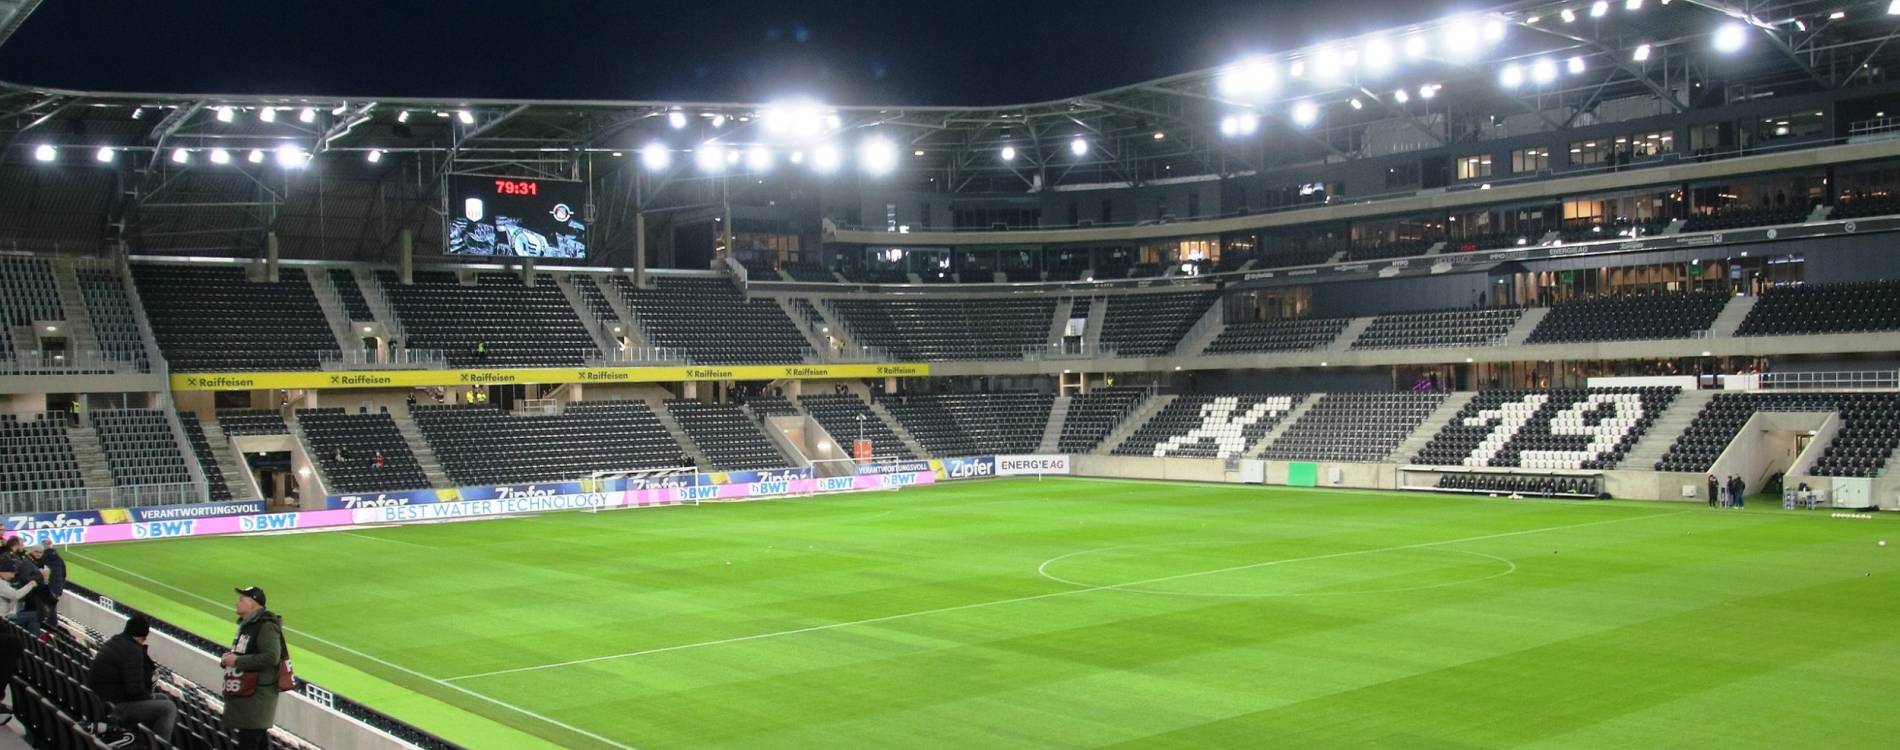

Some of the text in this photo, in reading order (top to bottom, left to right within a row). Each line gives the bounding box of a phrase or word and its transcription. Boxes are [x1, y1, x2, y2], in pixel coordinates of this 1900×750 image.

[495, 181, 537, 195] 79:31
[587, 371, 628, 380] Raiffeisen
[694, 369, 732, 379] Raiffeisen
[793, 367, 828, 377] Raiffeisen
[883, 366, 916, 375] Raiffeisen
[199, 377, 254, 387] Raiffeisen
[341, 375, 391, 385] Raiffeisen
[470, 373, 515, 382] Raiffeisen
[951, 459, 993, 477] Zipfer
[1049, 460, 1064, 469] AG
[828, 477, 854, 490] BWT
[891, 474, 916, 486] BWT
[688, 486, 718, 500] BWT
[760, 482, 787, 494] BWT
[141, 504, 260, 519] VERANTWORTUNGSVOLL
[386, 494, 608, 521] BEST WATER TECHNOLOGY
[256, 513, 297, 529] BWT
[150, 520, 193, 536] BWT
[36, 528, 84, 545] BWT
